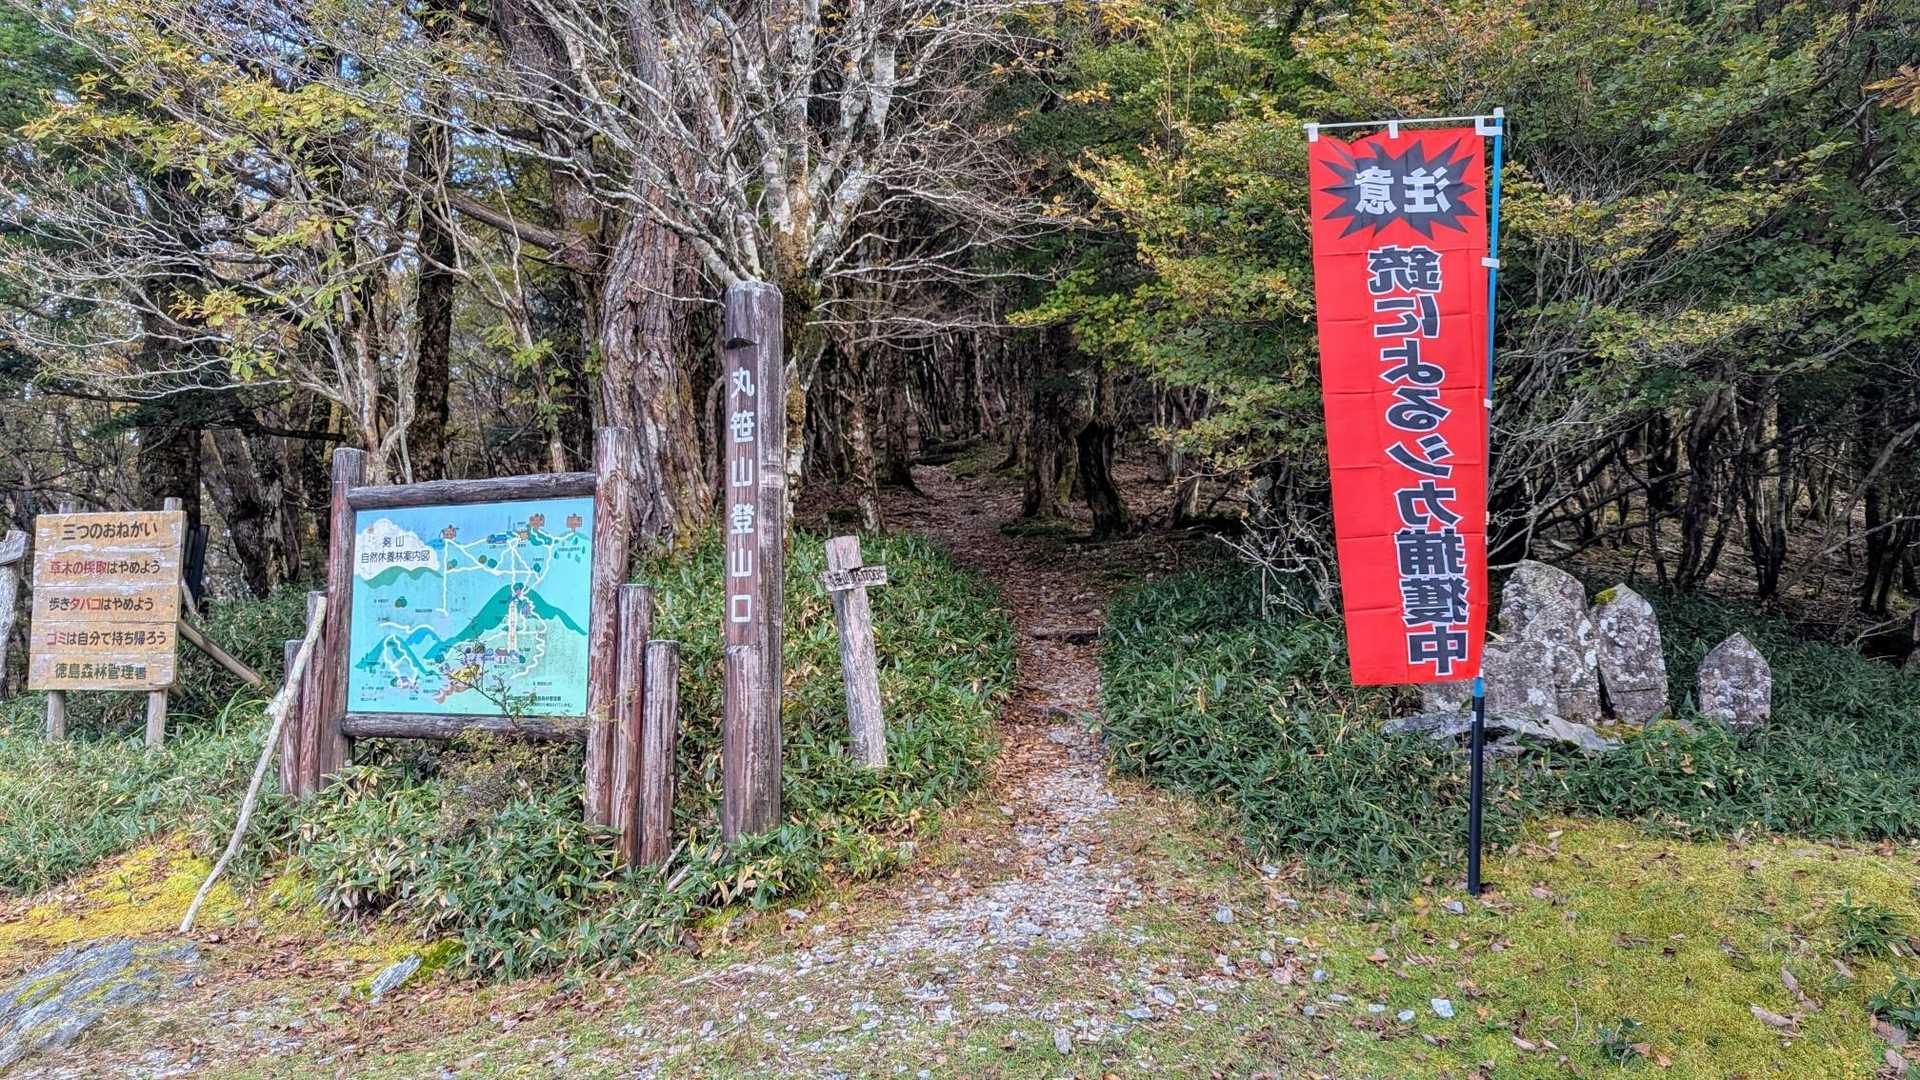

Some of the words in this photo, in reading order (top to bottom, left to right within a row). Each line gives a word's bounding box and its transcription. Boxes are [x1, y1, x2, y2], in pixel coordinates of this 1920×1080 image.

[730, 366, 755, 623] 丸笹山登山口
[62, 521, 158, 540] 三つのおねがい
[49, 560, 160, 576] 草木の採取はやめよう
[55, 662, 147, 680] 徳島森林管理署
